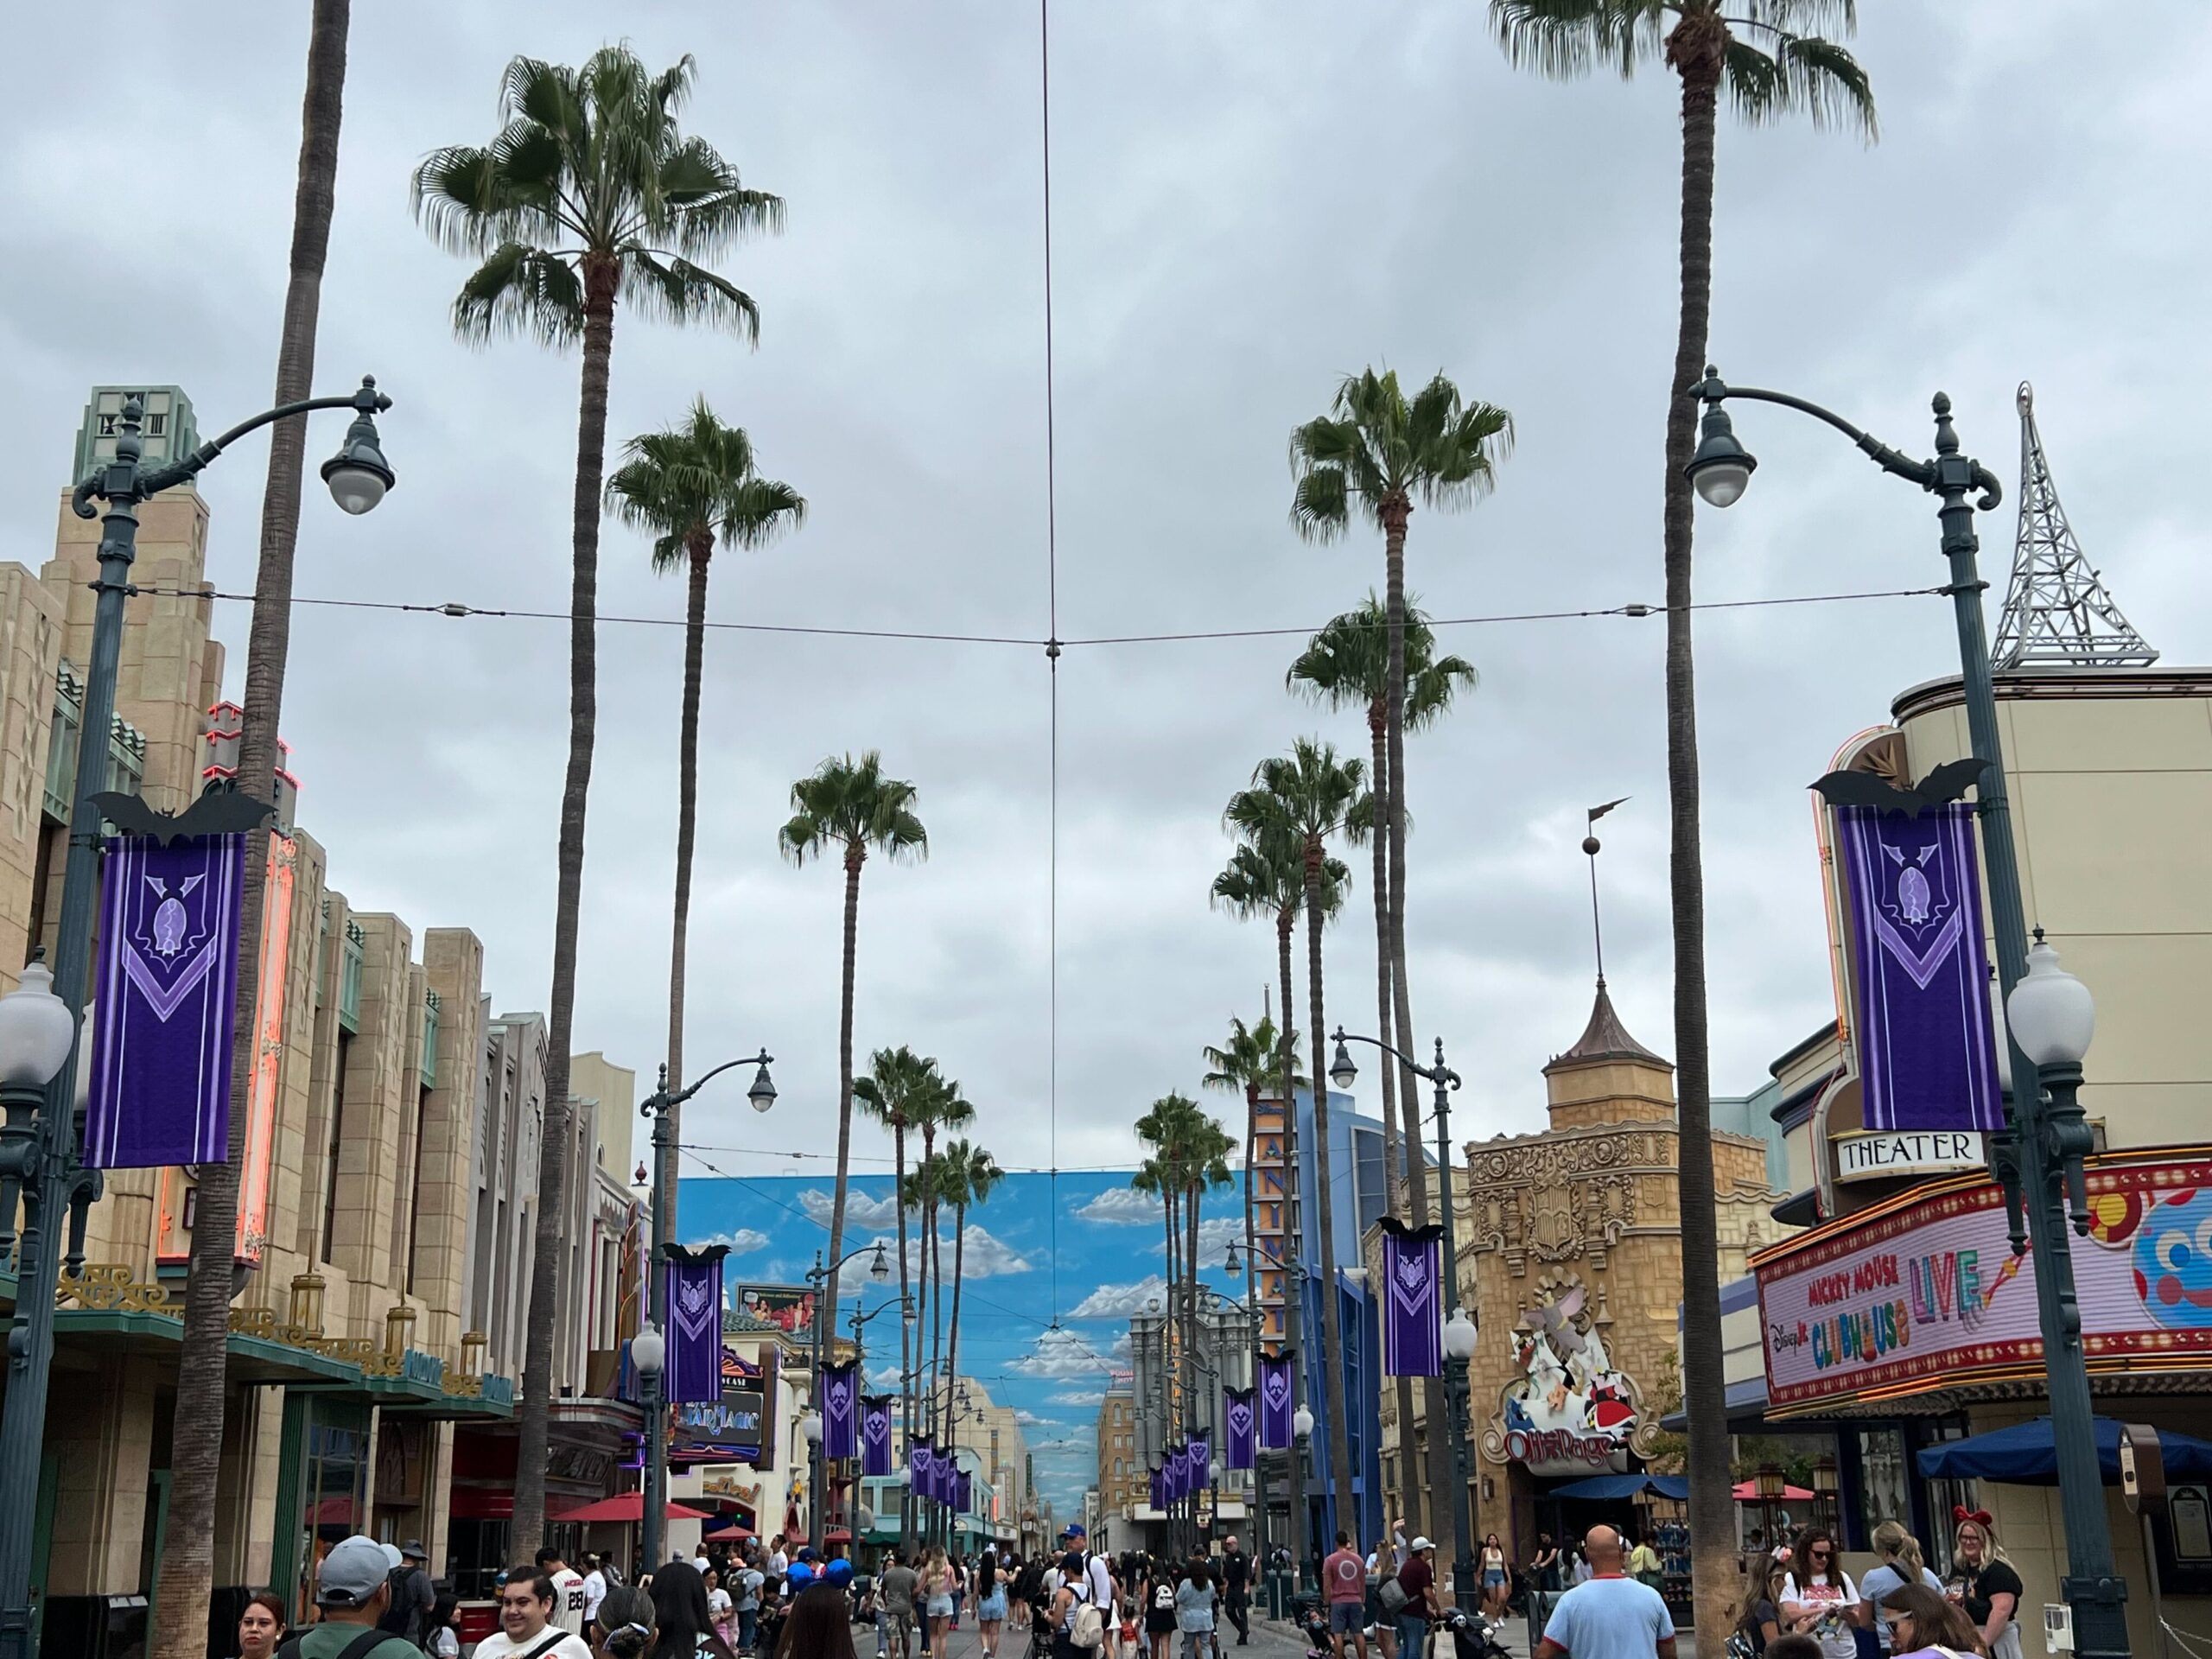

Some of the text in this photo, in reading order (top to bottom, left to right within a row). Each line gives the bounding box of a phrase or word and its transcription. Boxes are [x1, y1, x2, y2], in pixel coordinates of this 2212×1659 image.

[150, 415, 163, 434] III
[1843, 1134, 1974, 1169] THEATER
[1808, 1254, 1900, 1307] MICKEY MOUSE
[1910, 1249, 1980, 1324] LIVE
[1770, 1324, 1797, 1357] Disney
[569, 1591, 584, 1611] 28
